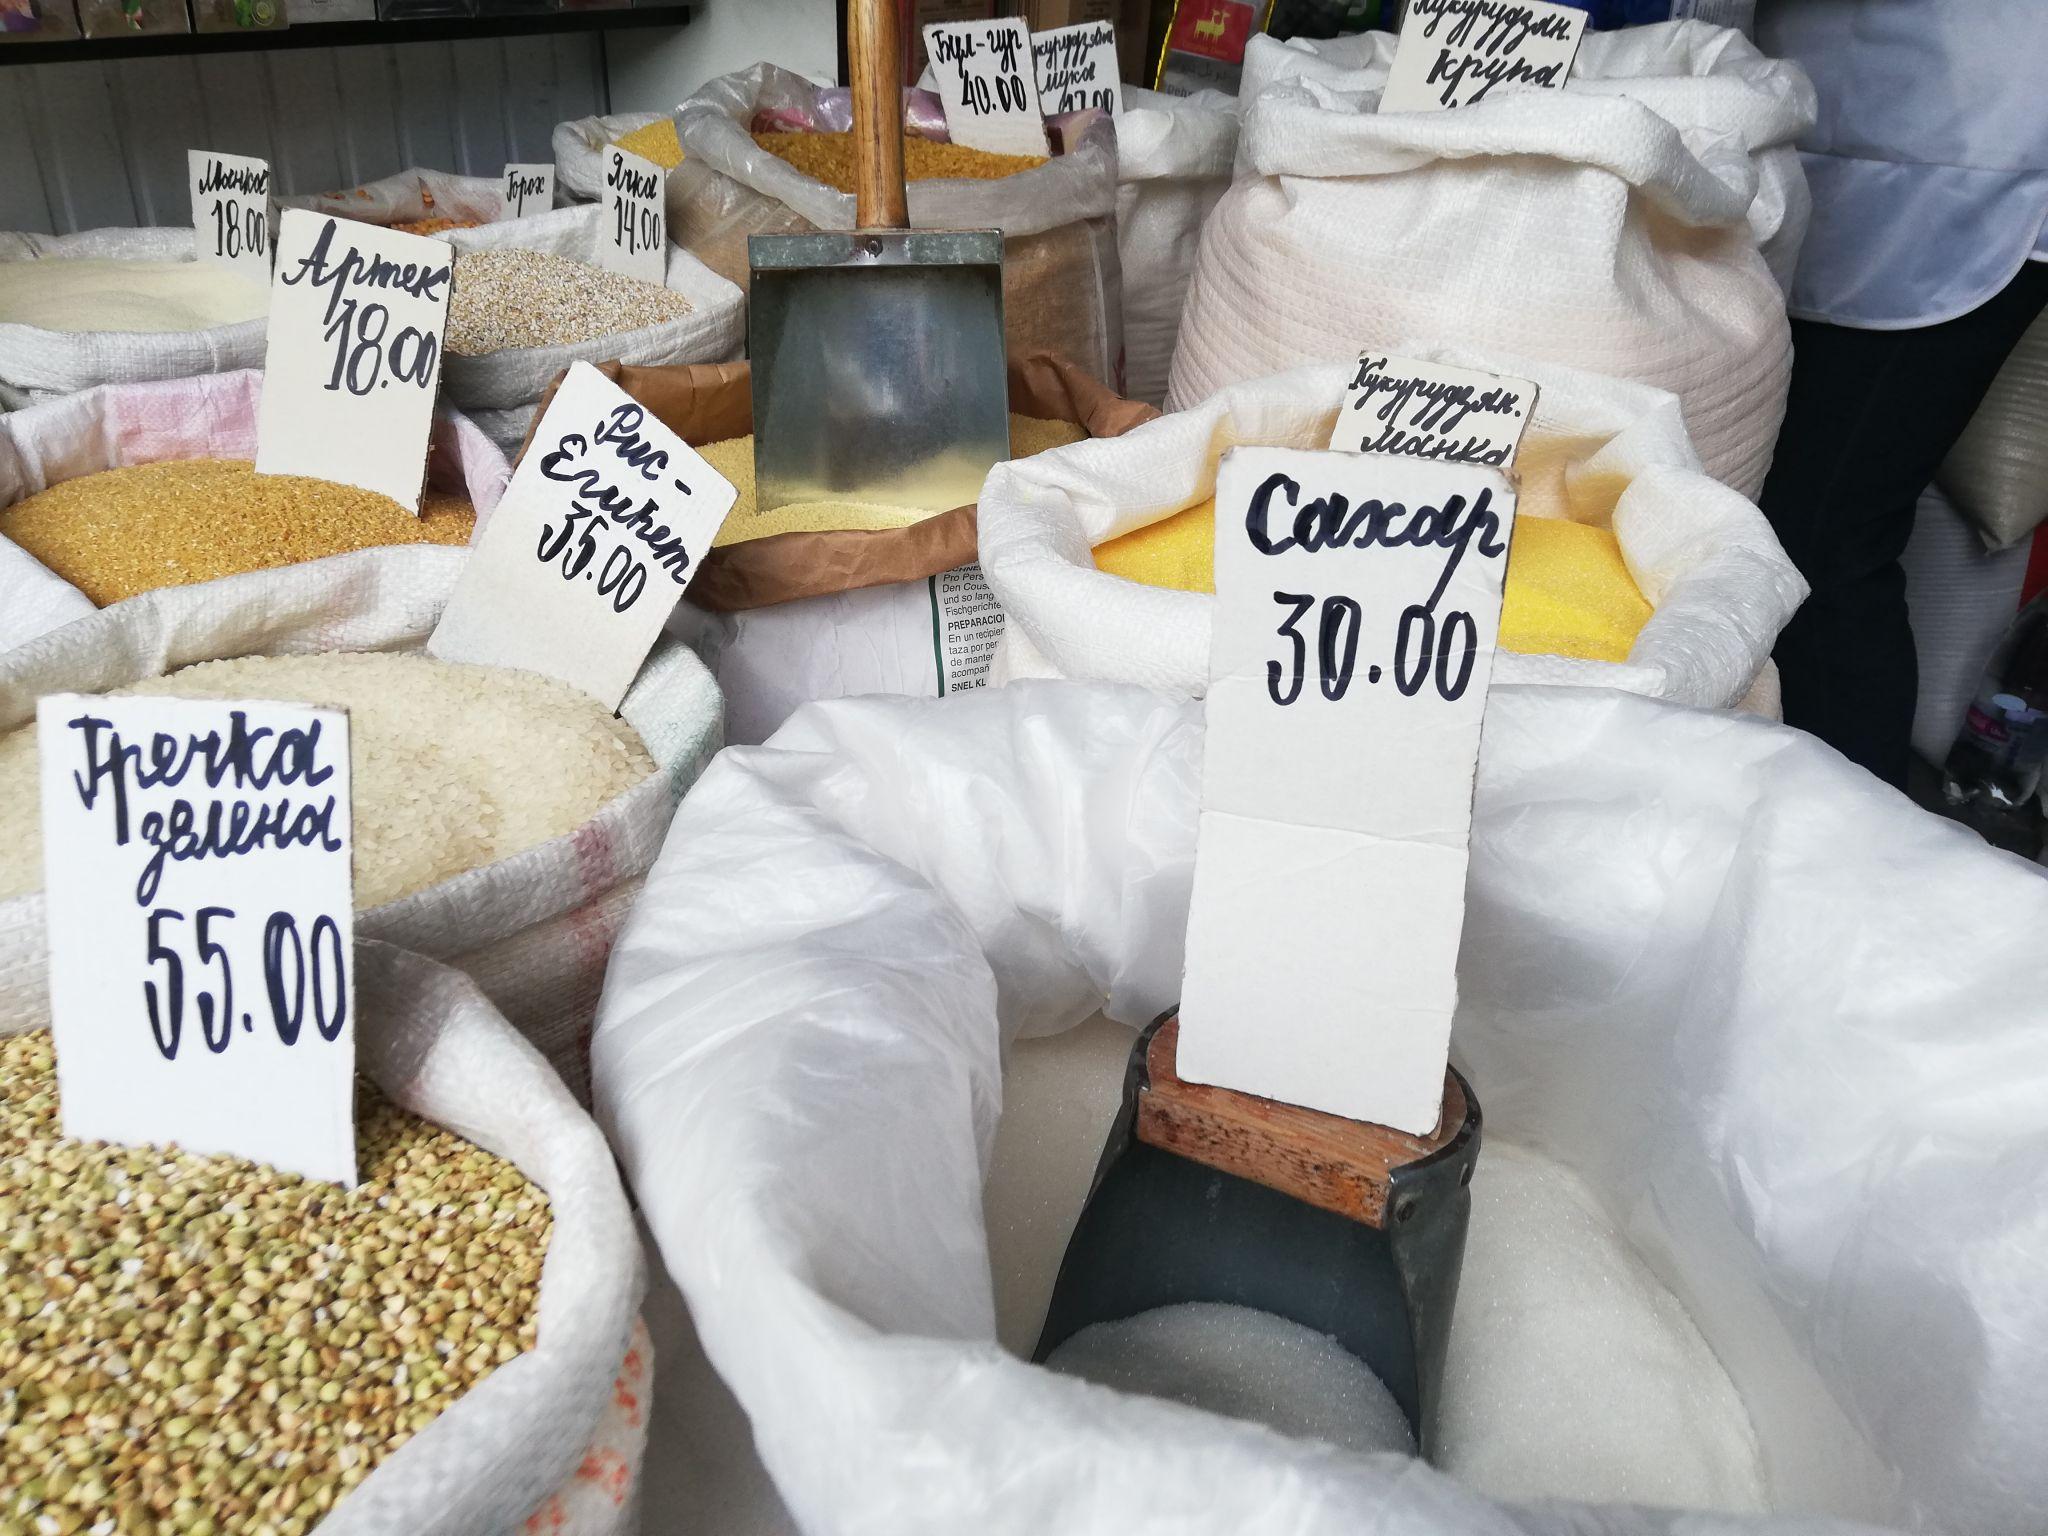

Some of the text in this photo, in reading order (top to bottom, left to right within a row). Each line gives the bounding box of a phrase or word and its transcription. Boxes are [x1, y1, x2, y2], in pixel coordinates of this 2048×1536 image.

[932, 28, 1023, 78] Бул-гур
[962, 70, 1026, 116] 40.00
[506, 170, 545, 218] Горох
[608, 152, 658, 200] Ячка
[211, 199, 265, 258] 18.00
[614, 196, 661, 255] 14.00
[282, 219, 450, 325] Артек
[324, 299, 437, 396] 18.00
[537, 501, 647, 614] 35.00
[1246, 473, 1505, 612] Сахар
[943, 584, 960, 593] Den
[944, 594, 960, 604] und
[975, 593, 994, 602] lang
[949, 634, 961, 643] En
[964, 633, 974, 642] un
[949, 641, 999, 655] taza por per
[951, 658, 962, 666] de
[1267, 591, 1478, 706] 30.00
[952, 678, 986, 692] SNEL KL
[68, 711, 333, 845] Гречка
[137, 795, 342, 906] зелена
[144, 906, 346, 1060] 55.00
